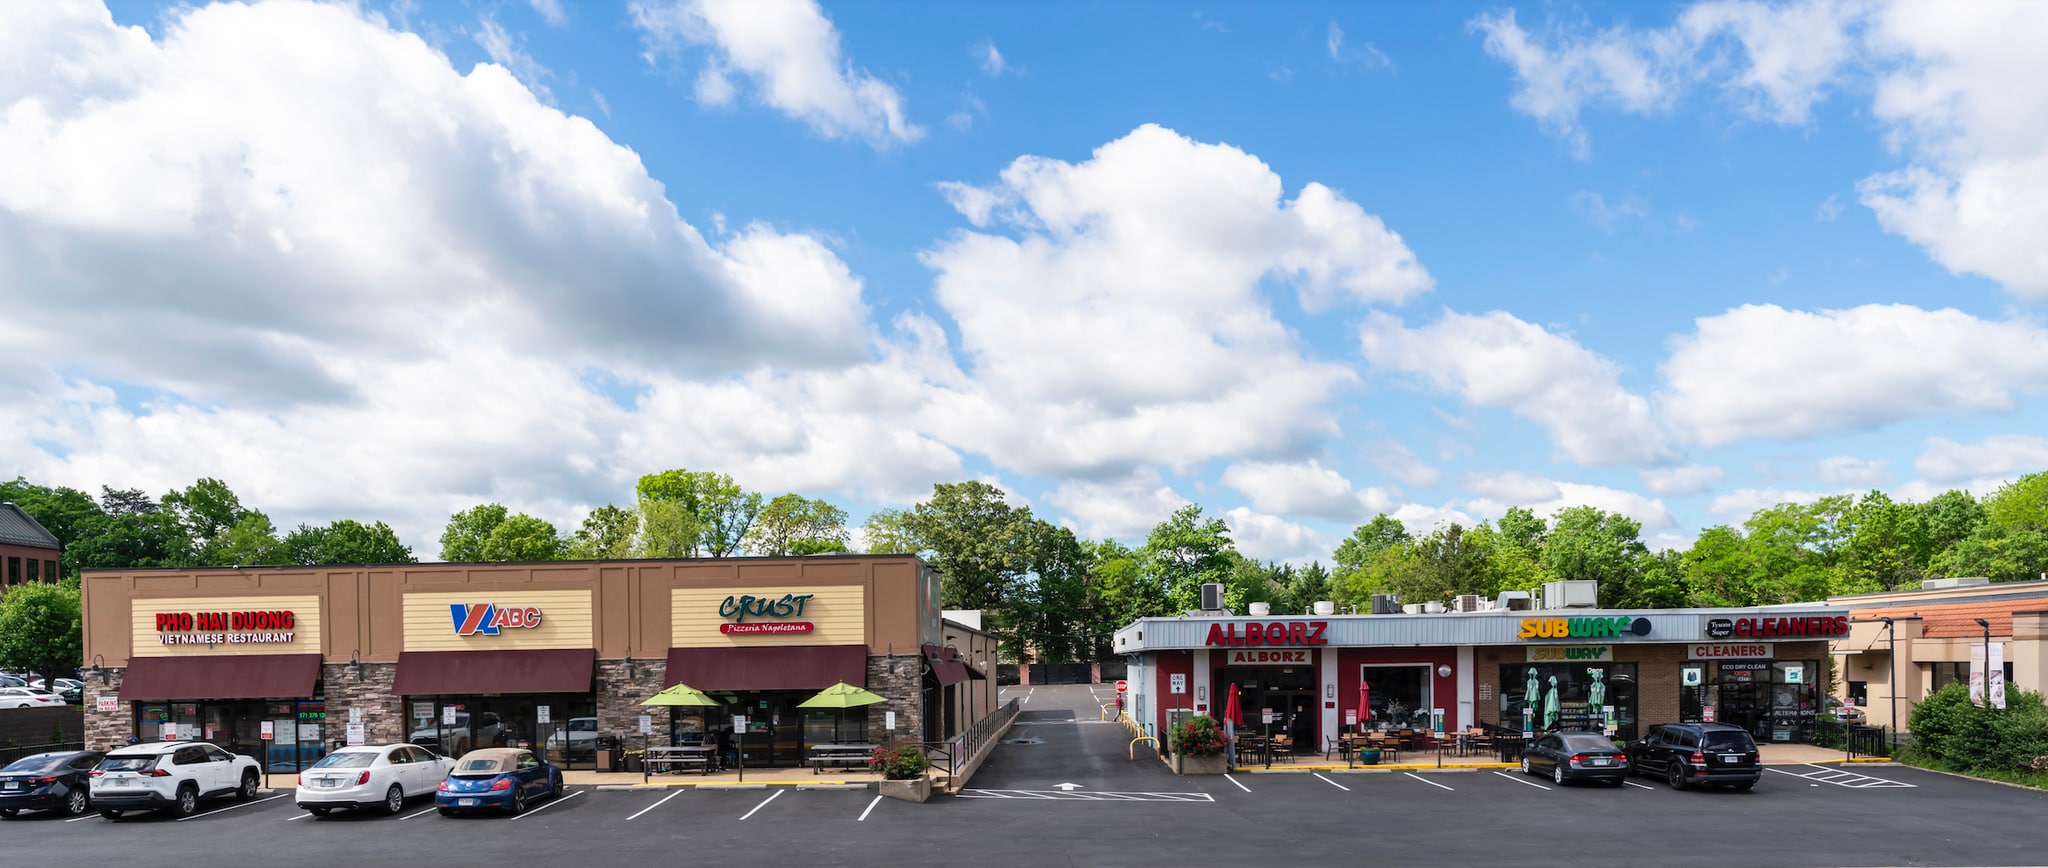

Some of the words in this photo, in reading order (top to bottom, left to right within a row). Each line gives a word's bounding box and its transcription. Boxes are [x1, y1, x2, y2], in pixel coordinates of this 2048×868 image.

[718, 593, 815, 622] CRUST
[156, 612, 192, 631] PHO
[197, 612, 228, 631] HAI
[231, 610, 295, 630] DUONG
[449, 602, 501, 635] VA
[488, 607, 541, 628] ABC
[1710, 621, 1731, 629] Tysons
[727, 624, 760, 632] Pizzeria
[762, 624, 806, 633] Napoletana
[1517, 616, 1631, 639] SUBWAY
[1711, 629, 1730, 637] Super
[1735, 616, 1848, 637] CLEANERS
[158, 634, 224, 644] VIETNAMESE
[227, 632, 294, 643] RESTAURANT
[1205, 622, 1328, 646] ALBORZ
[1234, 651, 1306, 662] ALBORZ
[1532, 646, 1607, 660] SUBWAY
[1696, 645, 1766, 657] CLEANERS
